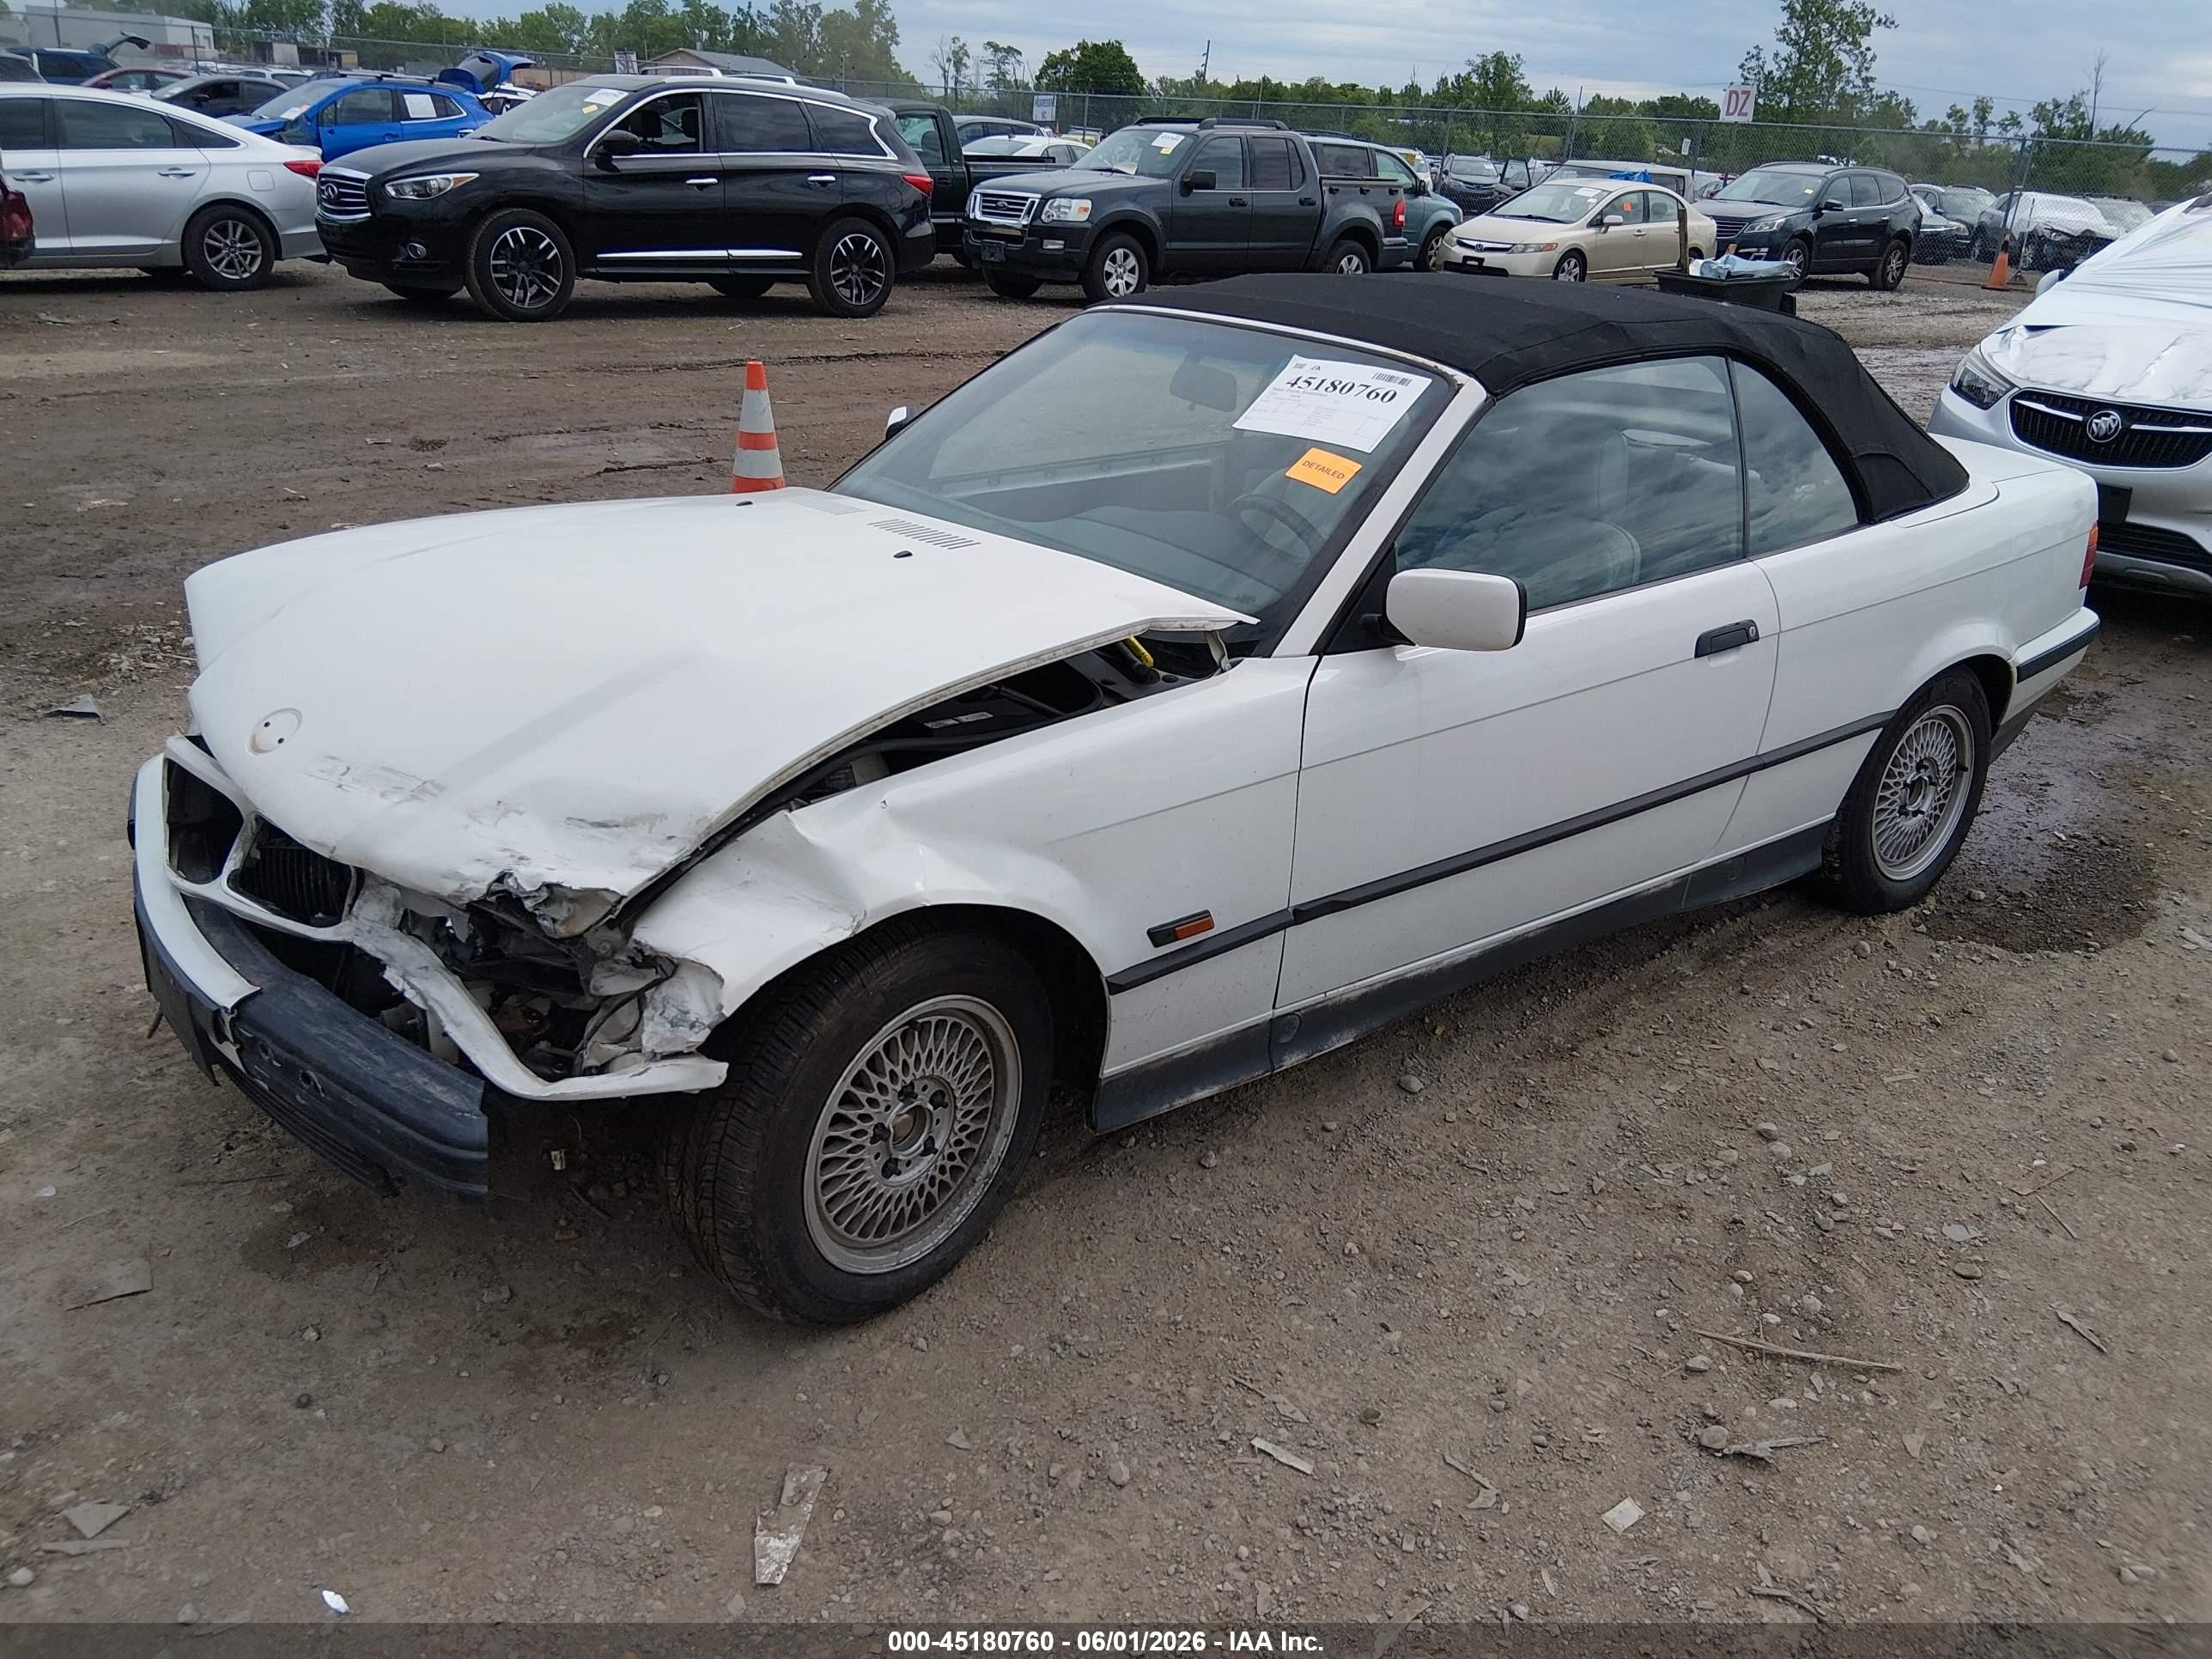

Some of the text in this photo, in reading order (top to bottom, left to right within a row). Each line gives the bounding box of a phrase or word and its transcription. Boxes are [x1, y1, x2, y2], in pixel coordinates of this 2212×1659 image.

[1725, 90, 1751, 116] DZ
[1286, 375, 1397, 404] 45180760
[1302, 460, 1346, 480] DETAILED
